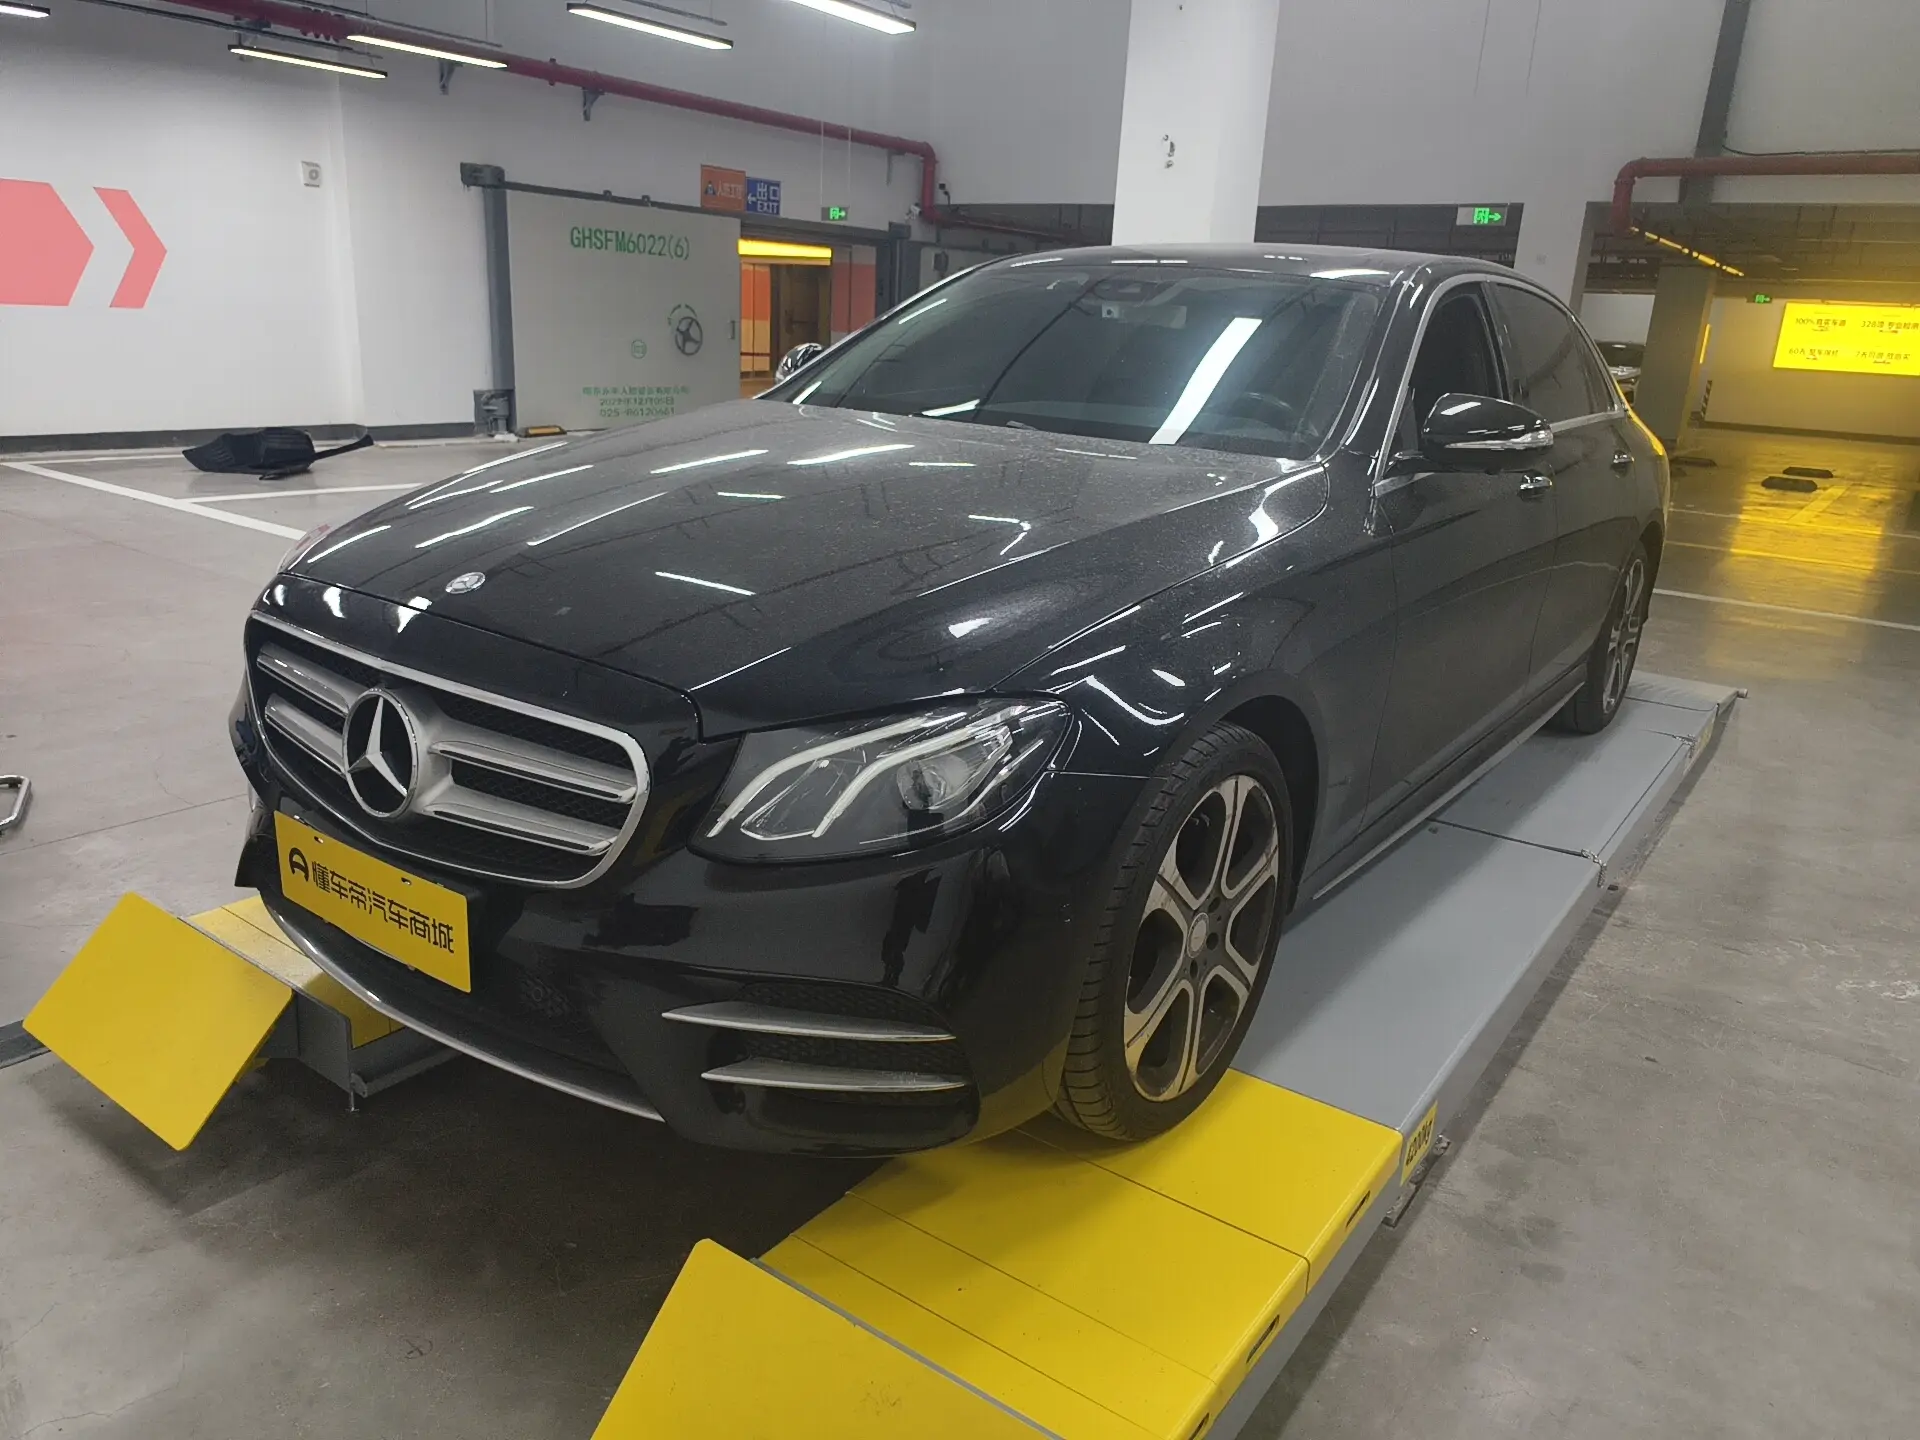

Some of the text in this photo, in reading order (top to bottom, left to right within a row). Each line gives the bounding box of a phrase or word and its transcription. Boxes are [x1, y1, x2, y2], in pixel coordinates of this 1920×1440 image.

[756, 182, 780, 200] 出口
[757, 201, 779, 214] EXIT
[570, 226, 690, 260] GHSFM6022(6)
[311, 860, 454, 954] 懂车帝汽车商城
